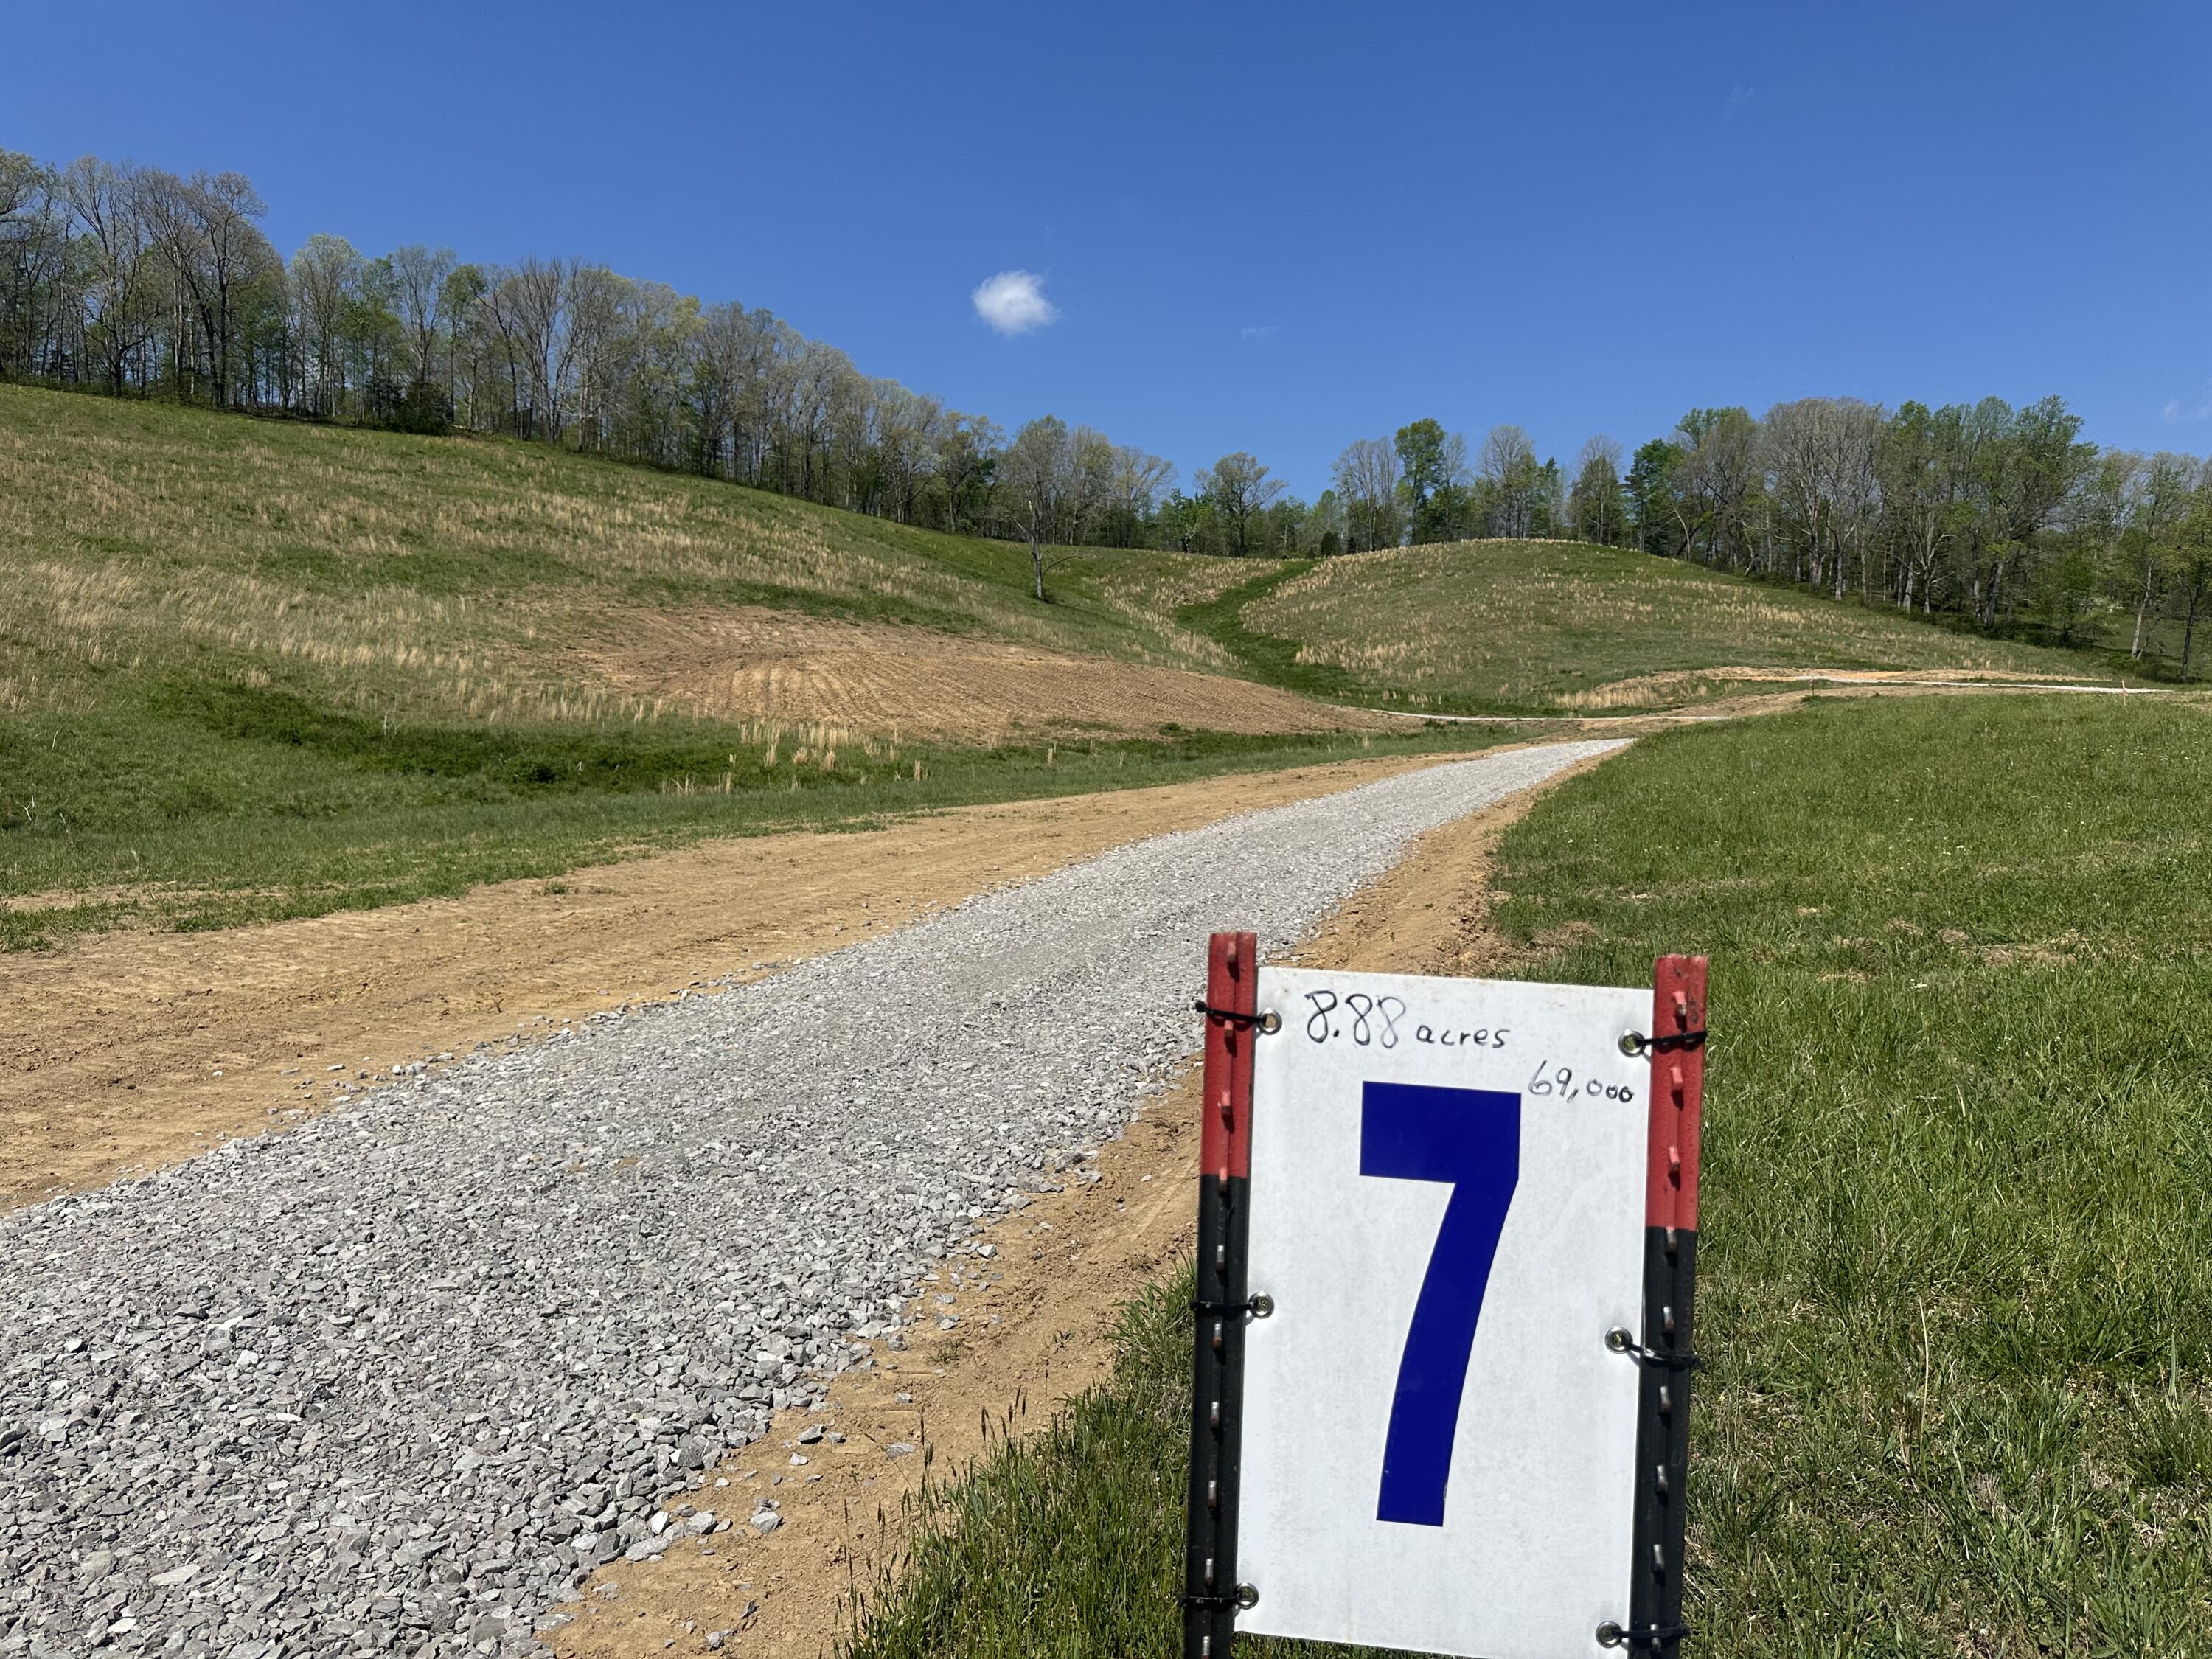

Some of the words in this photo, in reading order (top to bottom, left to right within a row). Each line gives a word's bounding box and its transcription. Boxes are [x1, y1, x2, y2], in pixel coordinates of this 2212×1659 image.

[1304, 990, 1405, 1048] 8.88
[1416, 1025, 1511, 1048] acres
[1528, 1060, 1633, 1102] 69,000
[1360, 1081, 1521, 1526] 7
